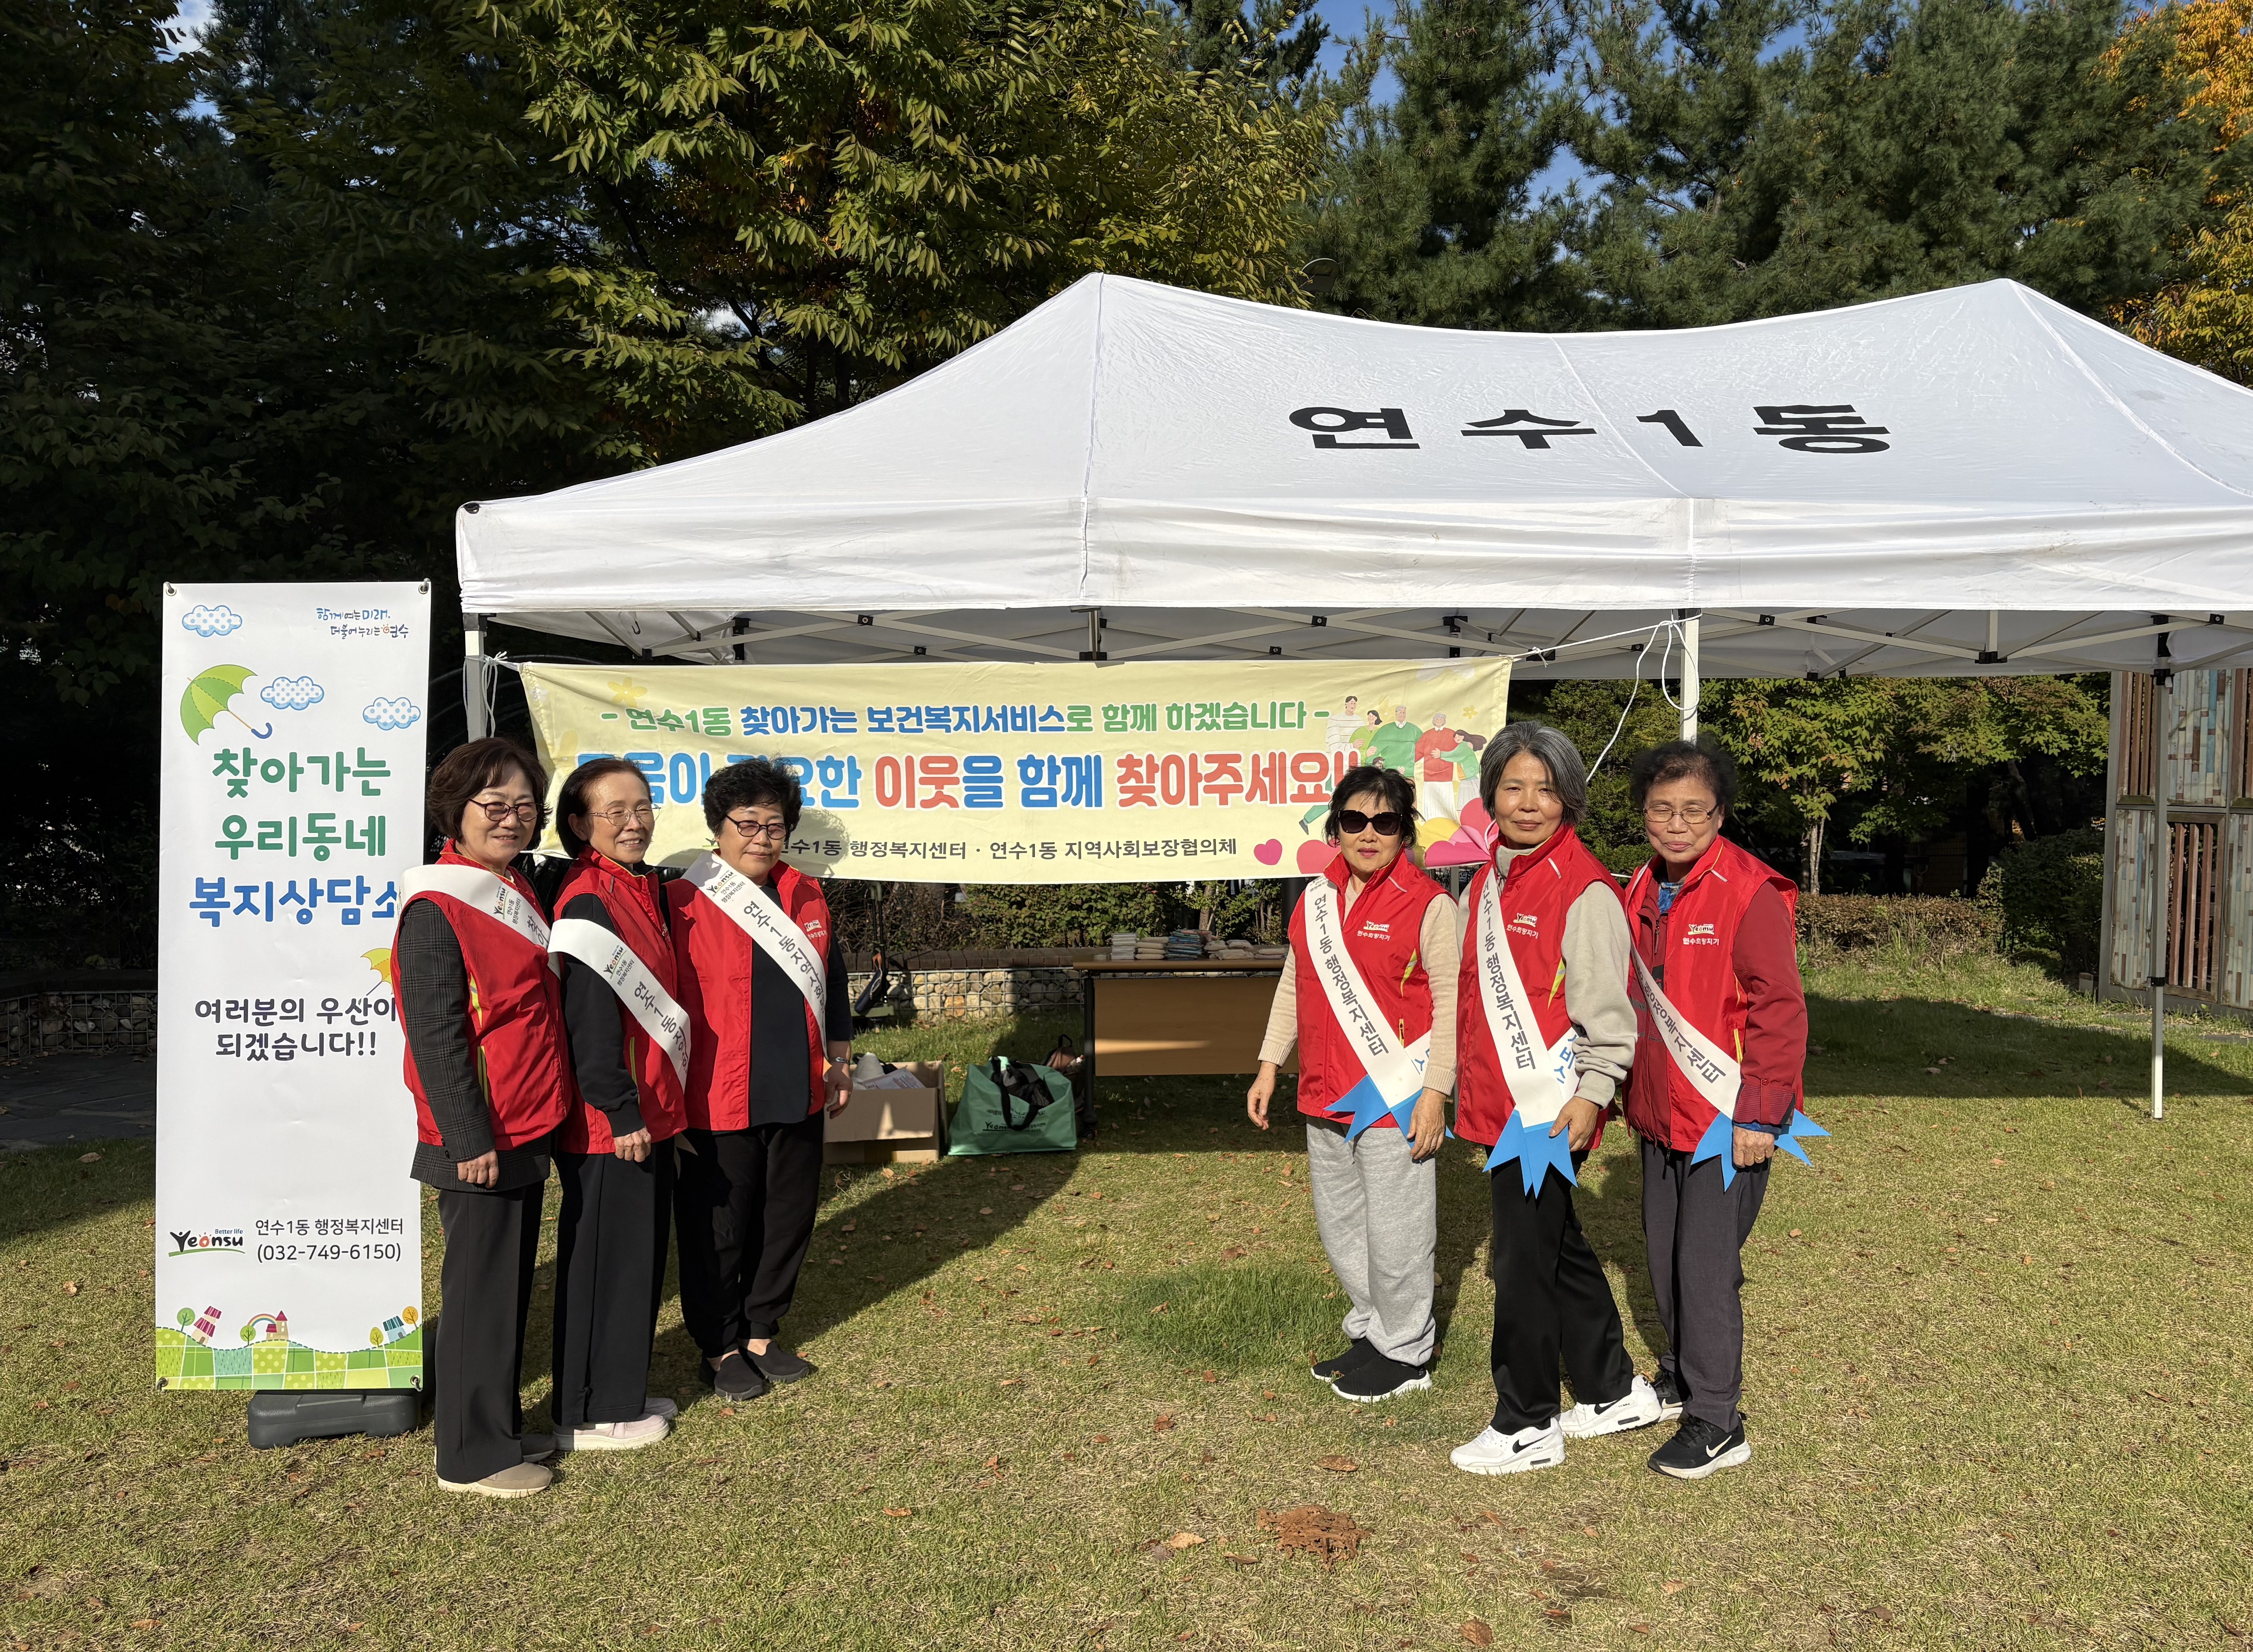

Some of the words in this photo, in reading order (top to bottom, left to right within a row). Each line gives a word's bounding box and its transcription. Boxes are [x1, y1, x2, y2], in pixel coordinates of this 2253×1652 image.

[627, 708, 731, 736] 연수1동
[741, 707, 857, 735] 찾아가는
[868, 706, 1093, 733] 보건복지서비스로
[1103, 704, 1156, 732] 함께
[1167, 701, 1307, 731] 하겠습니다
[213, 748, 391, 798] 찾아가는
[876, 756, 1003, 809] 이웃을
[1018, 754, 1102, 807] 함께
[215, 813, 385, 861] 우리동네
[850, 841, 966, 859] 행정복지센터
[990, 842, 1057, 860] 연수1동
[1065, 838, 1236, 860] 지역사회보장협의체
[1314, 893, 1333, 955] 연수1동
[1324, 953, 1390, 1056] 행정복지센터
[195, 998, 304, 1026] 여러분의
[316, 997, 396, 1025] 우산이
[1486, 952, 1536, 1070] 행정복지센터
[216, 1031, 376, 1061] 되겠습니다!!
[170, 1230, 243, 1253] Yeonsu
[255, 1219, 310, 1236] 연수1동
[315, 1218, 402, 1236] 행정복지센터
[257, 1242, 401, 1264] (032-749-6150)
